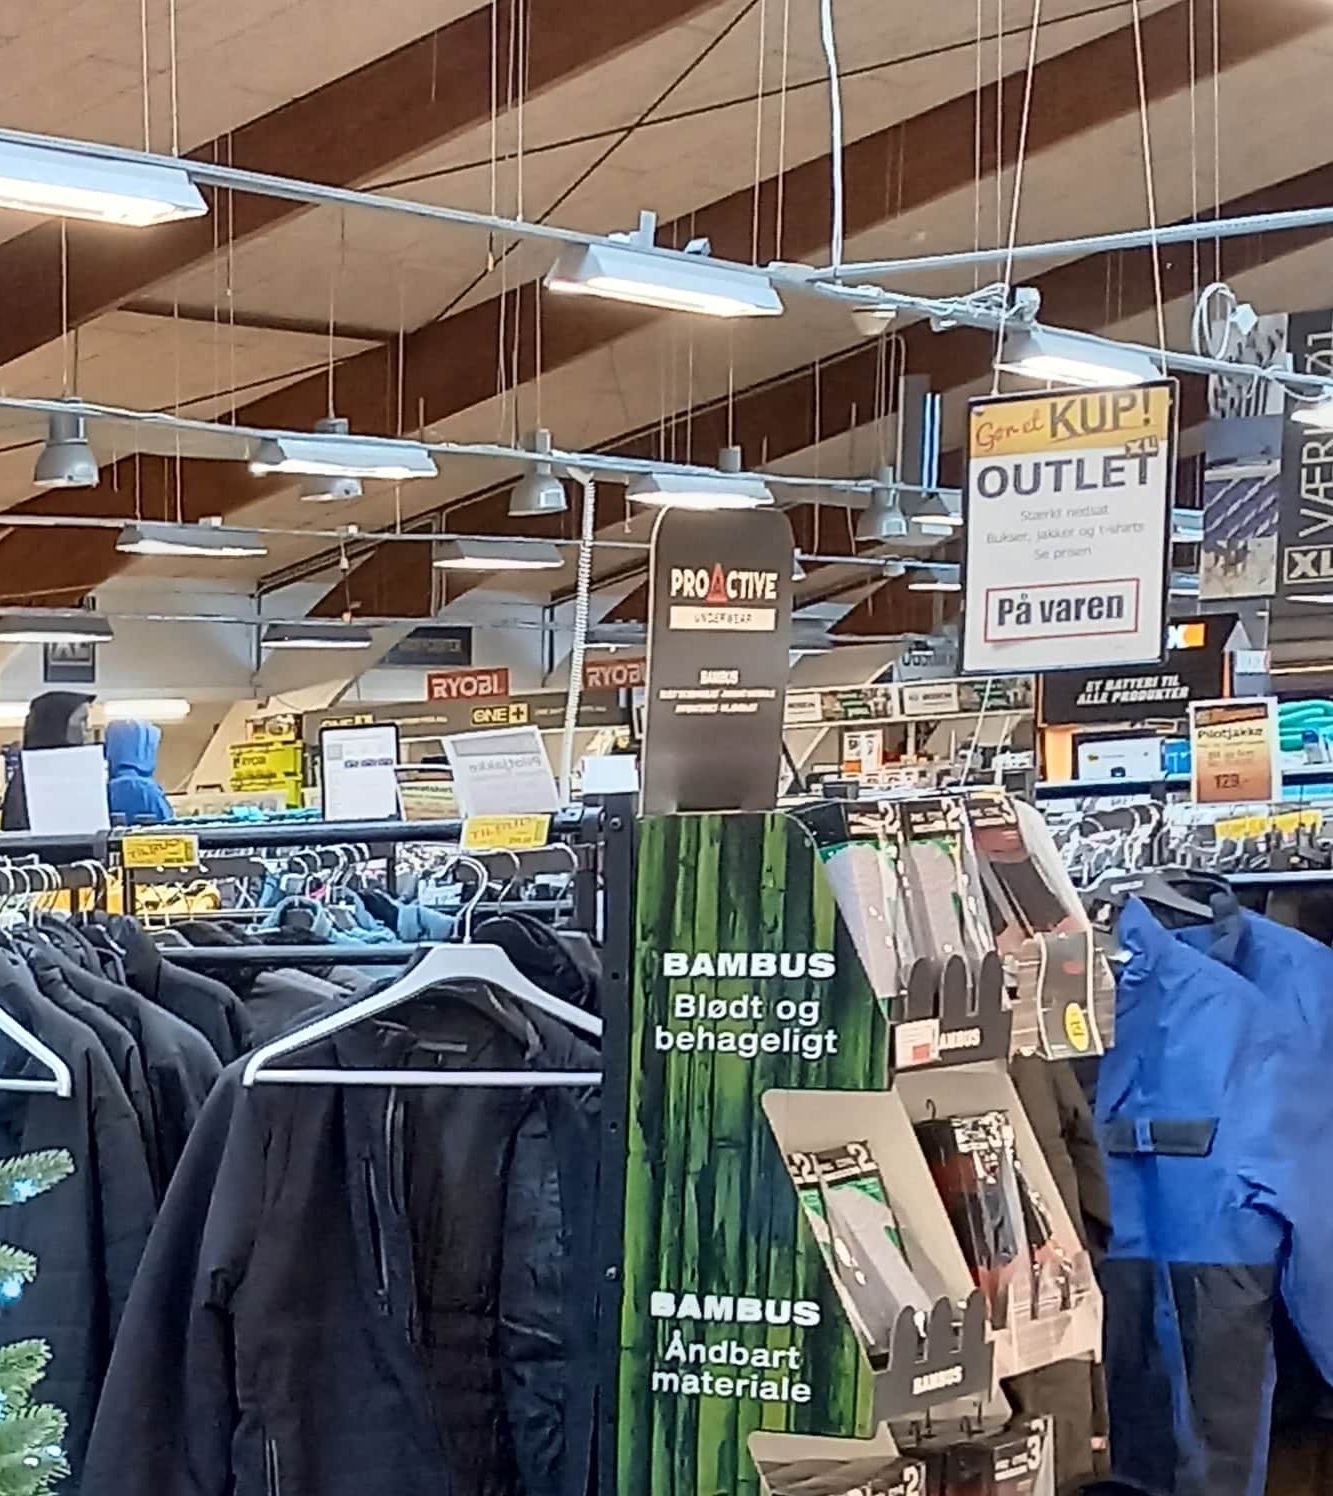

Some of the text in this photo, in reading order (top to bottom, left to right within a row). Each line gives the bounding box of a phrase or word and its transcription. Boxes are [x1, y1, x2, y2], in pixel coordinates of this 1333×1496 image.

[1049, 388, 1152, 439] KUP!
[977, 453, 1149, 499] OUTLET
[670, 562, 779, 604] PROACTIVE
[997, 592, 1124, 626] På varen
[432, 674, 501, 699] RYOBI
[586, 664, 645, 688] RYOB
[663, 952, 837, 978] BAMBUS
[674, 993, 821, 1027] Blødt og
[655, 1024, 839, 1060] behageligt
[650, 1291, 821, 1327] BAMBUS
[664, 1329, 801, 1370] Åndbart
[651, 1370, 812, 1403] materiale
